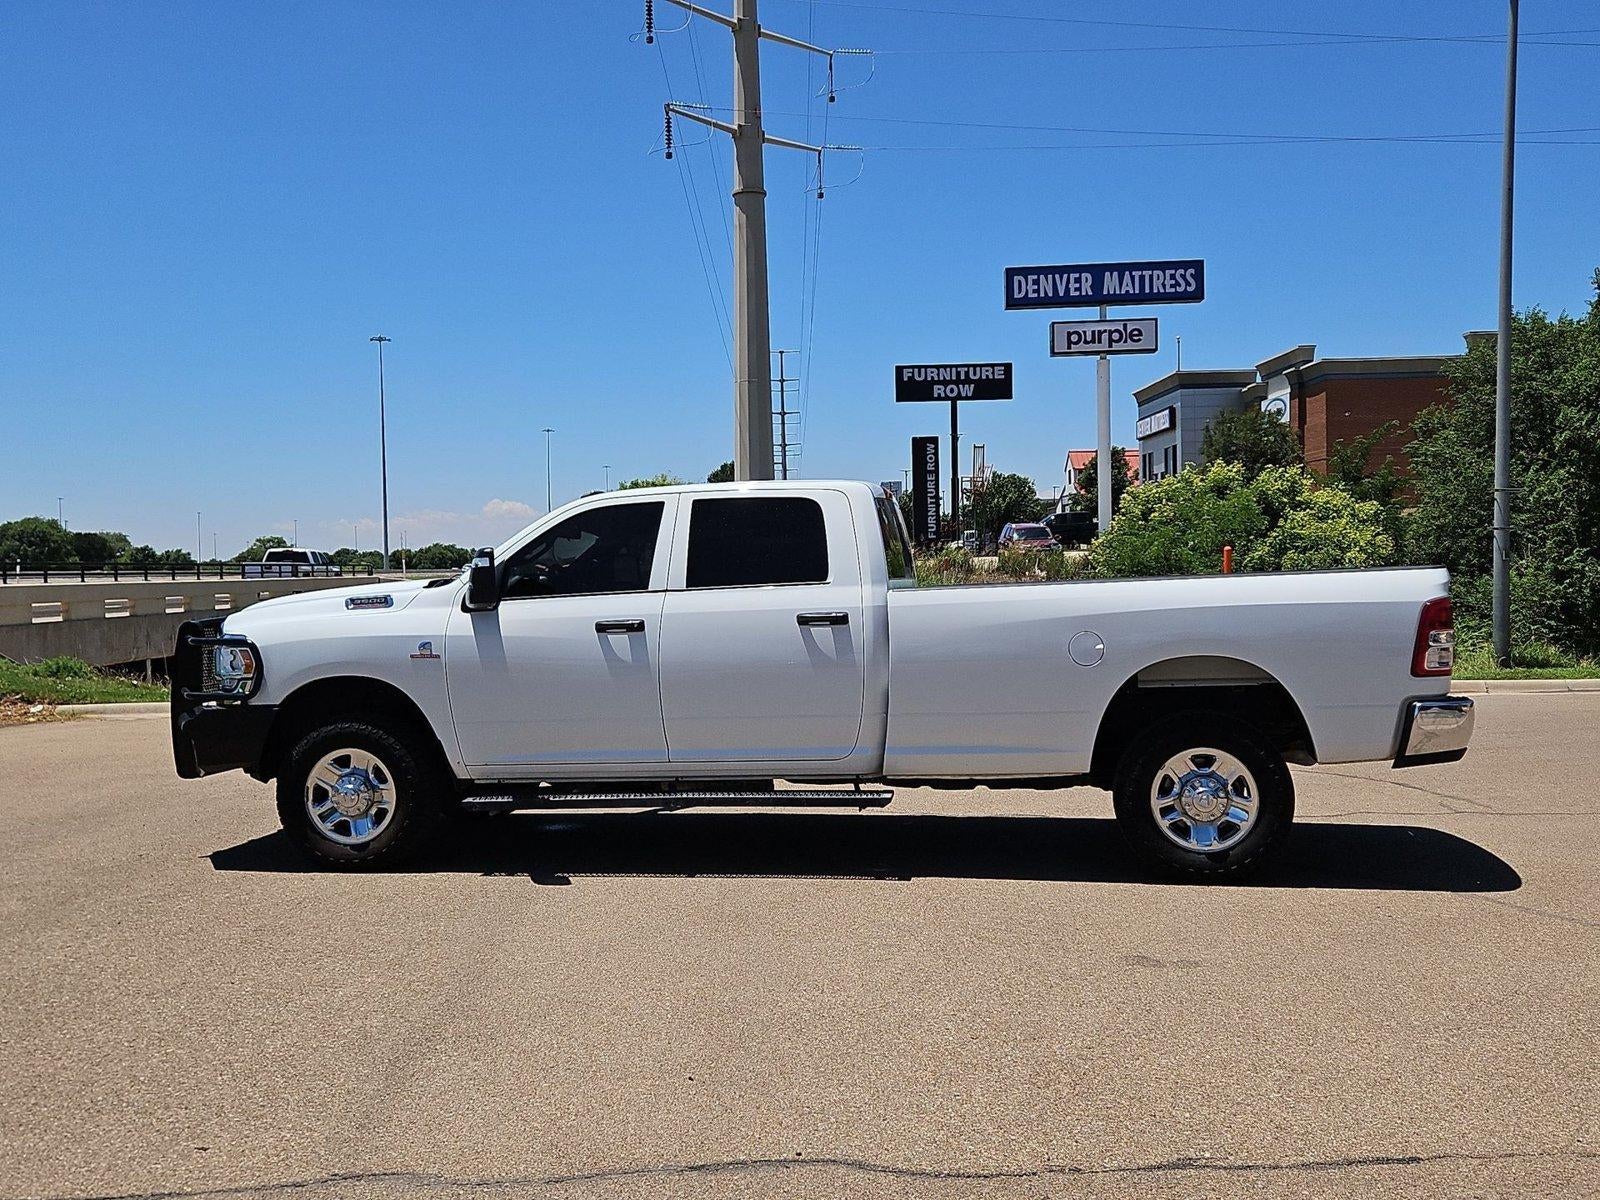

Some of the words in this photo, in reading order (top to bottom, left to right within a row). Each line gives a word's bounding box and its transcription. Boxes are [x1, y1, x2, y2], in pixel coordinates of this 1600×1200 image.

[1013, 272, 1093, 299] DENVER
[1103, 268, 1197, 295] MATTRESS
[1066, 323, 1144, 350] purple
[903, 366, 1005, 381] FURNITURE
[933, 384, 975, 398] ROW
[926, 443, 936, 471] ROW
[926, 473, 937, 539] FURNITURE
